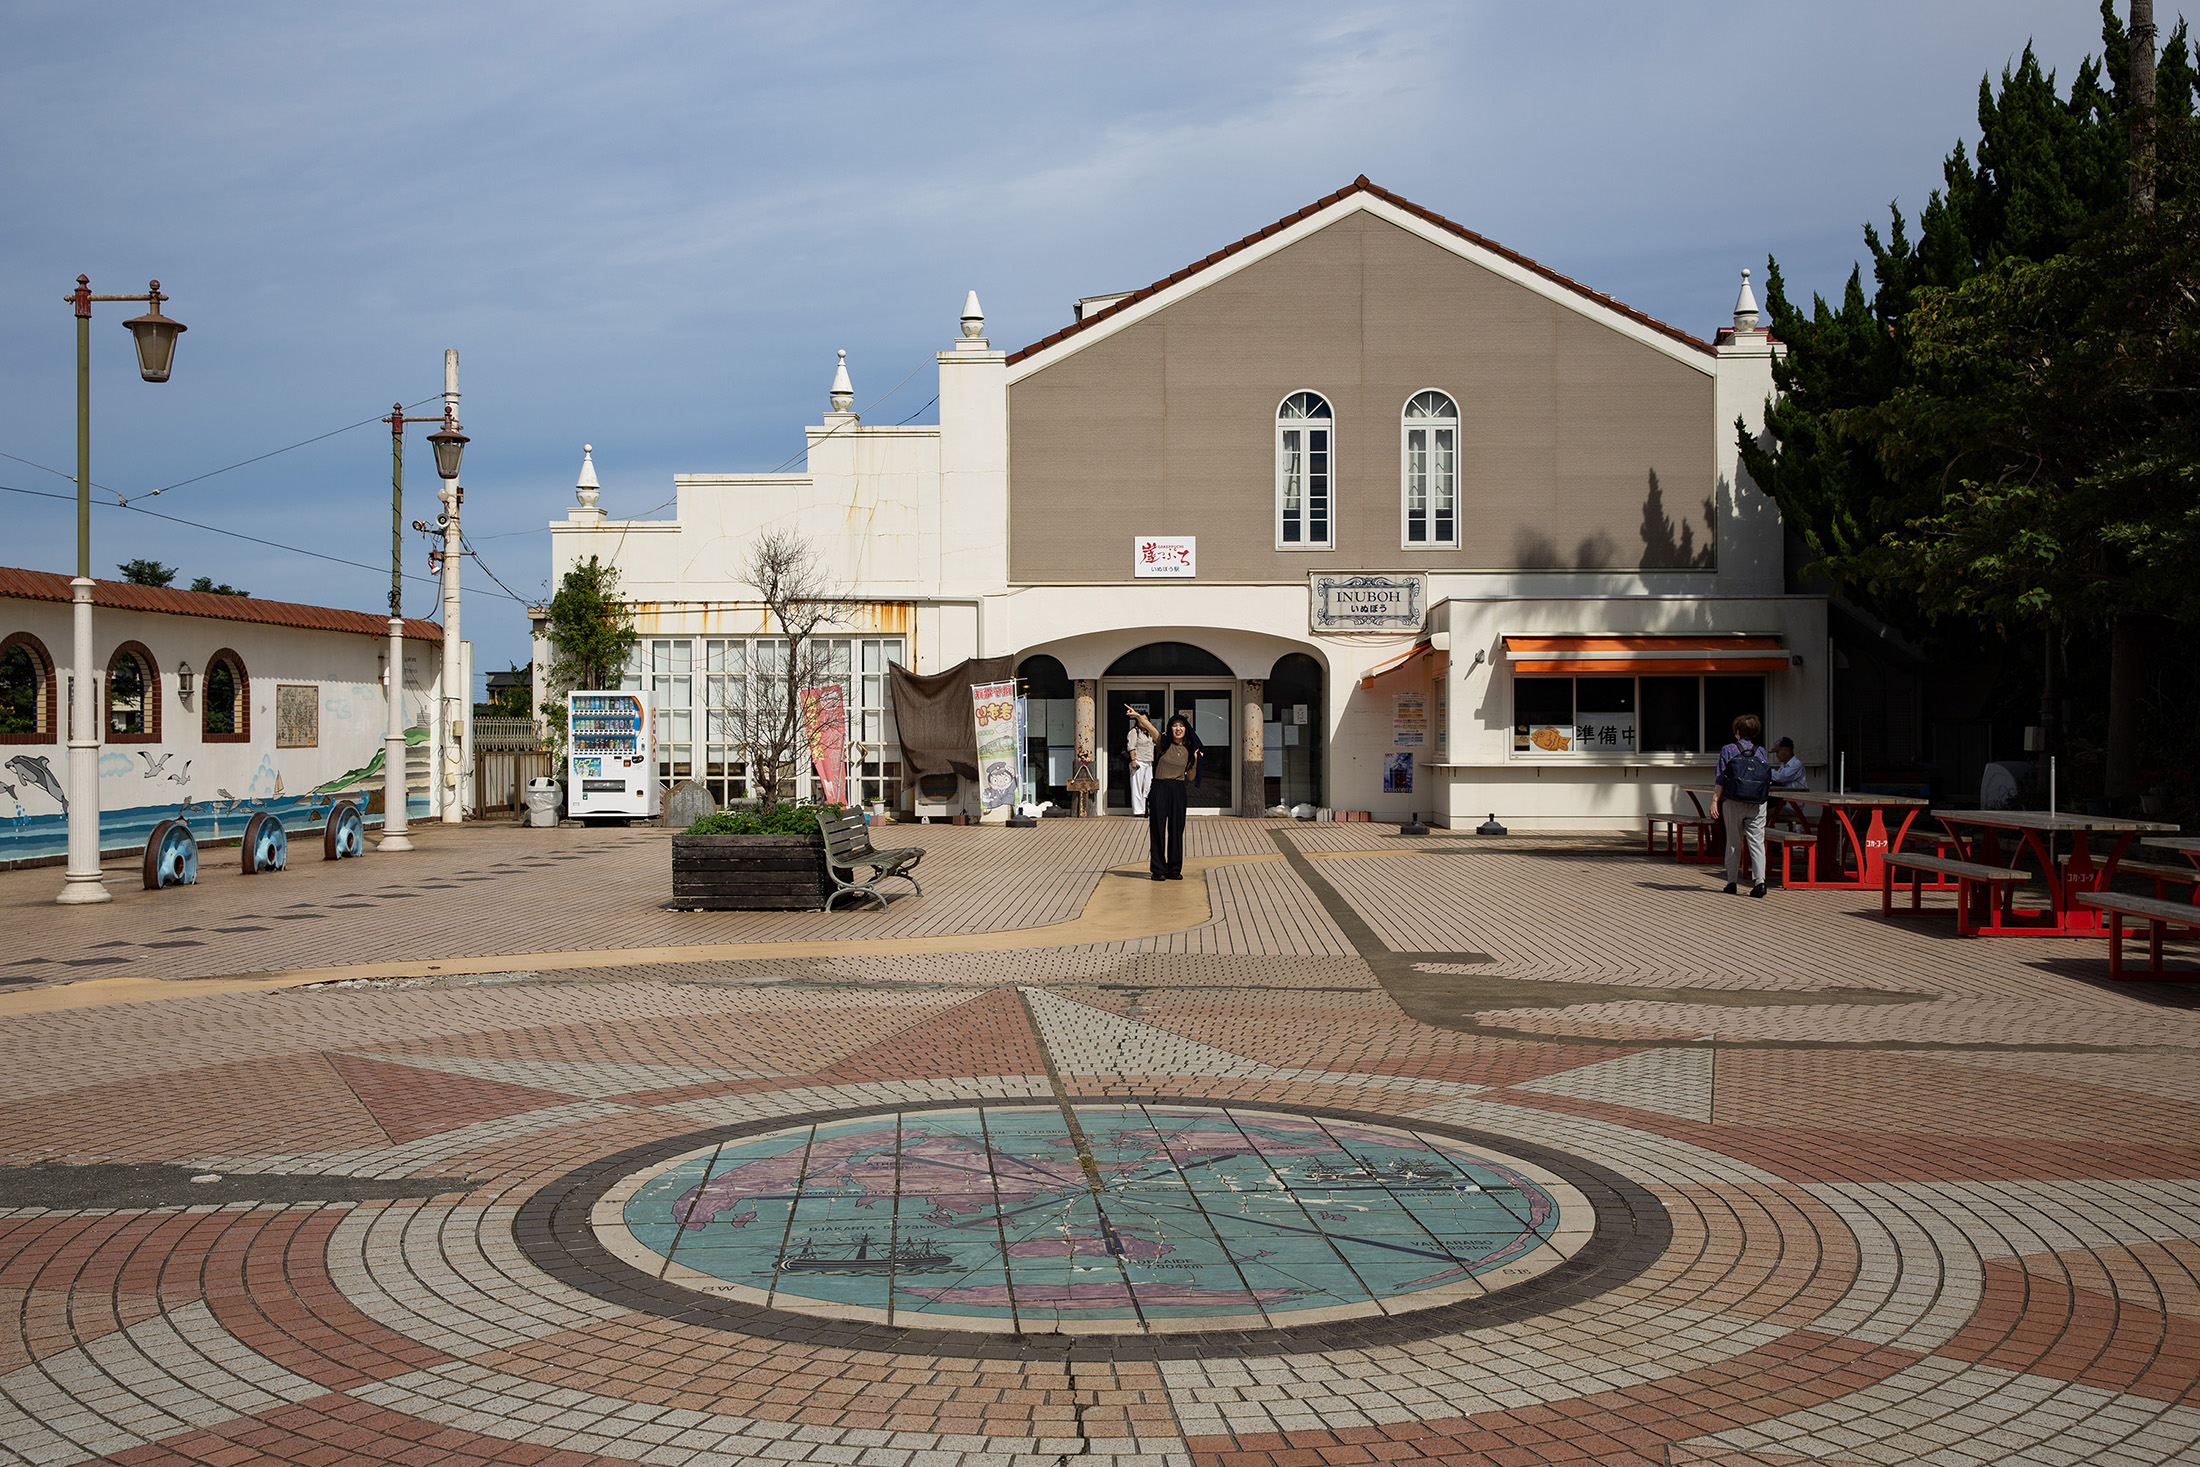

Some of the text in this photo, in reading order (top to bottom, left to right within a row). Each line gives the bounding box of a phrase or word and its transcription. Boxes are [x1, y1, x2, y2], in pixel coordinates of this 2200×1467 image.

[1337, 592, 1400, 602] INUBOH
[1351, 605, 1387, 613] いぬぼう
[1576, 725, 1635, 745] 準備中
